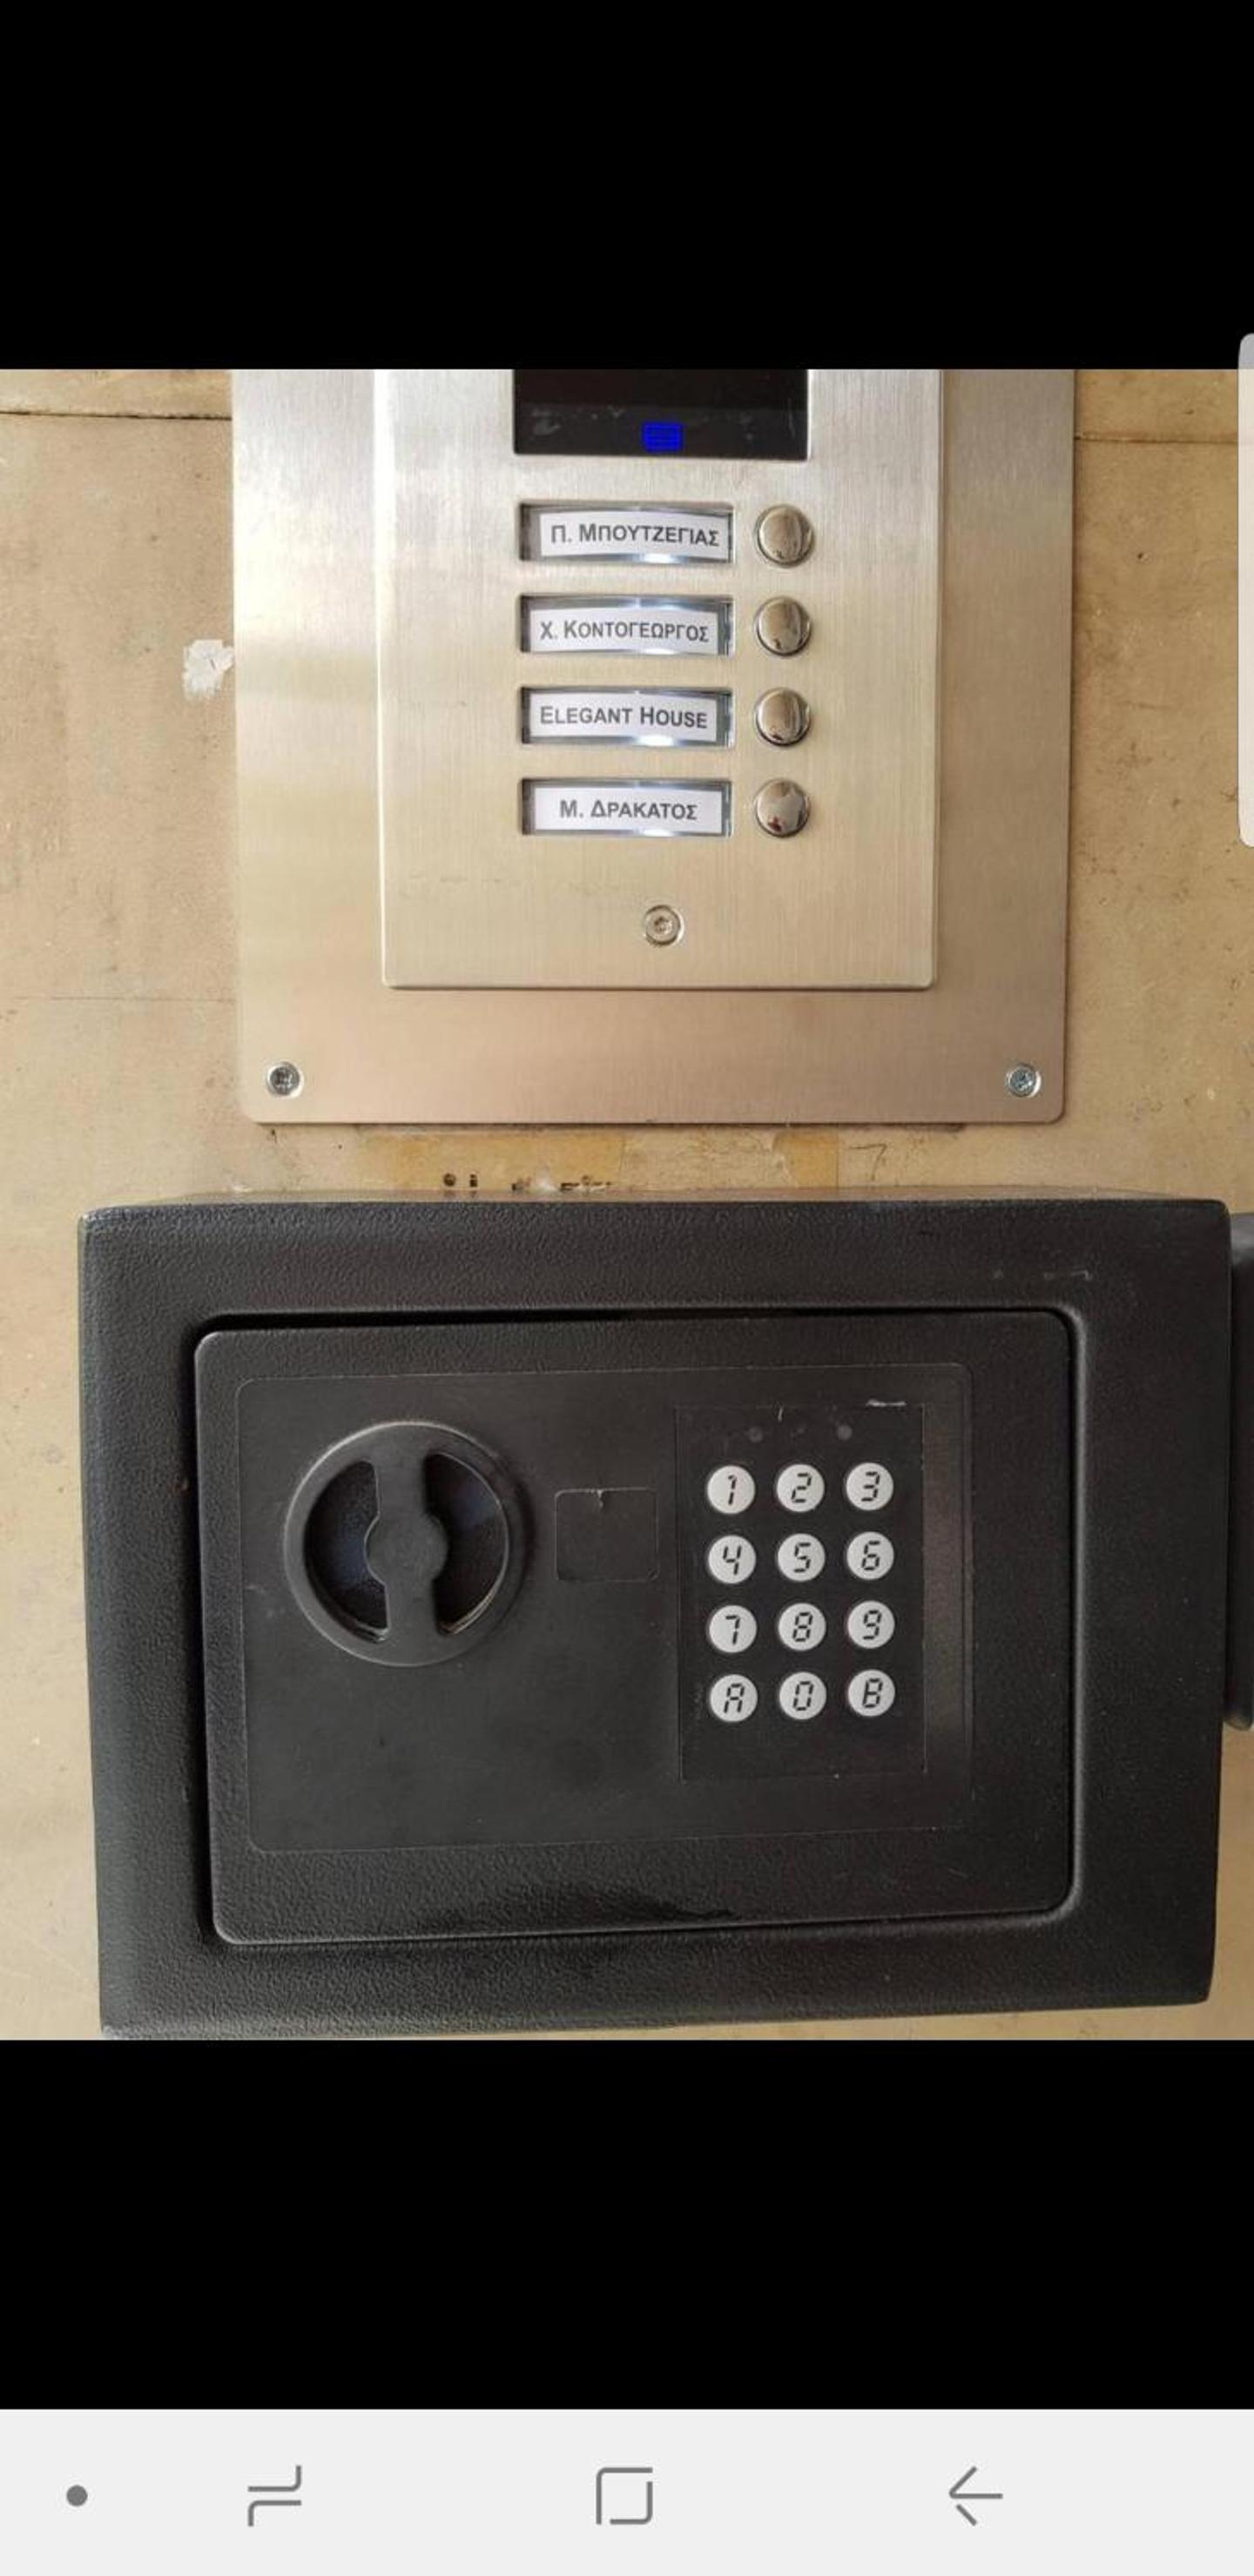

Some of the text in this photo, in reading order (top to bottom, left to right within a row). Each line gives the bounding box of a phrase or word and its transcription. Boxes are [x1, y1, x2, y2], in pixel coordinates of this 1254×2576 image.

[550, 523, 720, 548] Π. ΜΠΟΥΤΖΕΓΙΑΣ
[540, 621, 710, 642] Χ. ΚΟΝΤΟΓΕΩΡΓΟΣ
[541, 706, 708, 730] ELEGANT HOUSE
[560, 799, 698, 820] Μ. ΔΡΑΚΑΤΟΣ
[727, 1470, 881, 1505] 1 2 3
[722, 1540, 881, 1576] 4 5 6
[725, 1609, 883, 1645] 7 8 9
[723, 1678, 884, 1714] A 0 B
